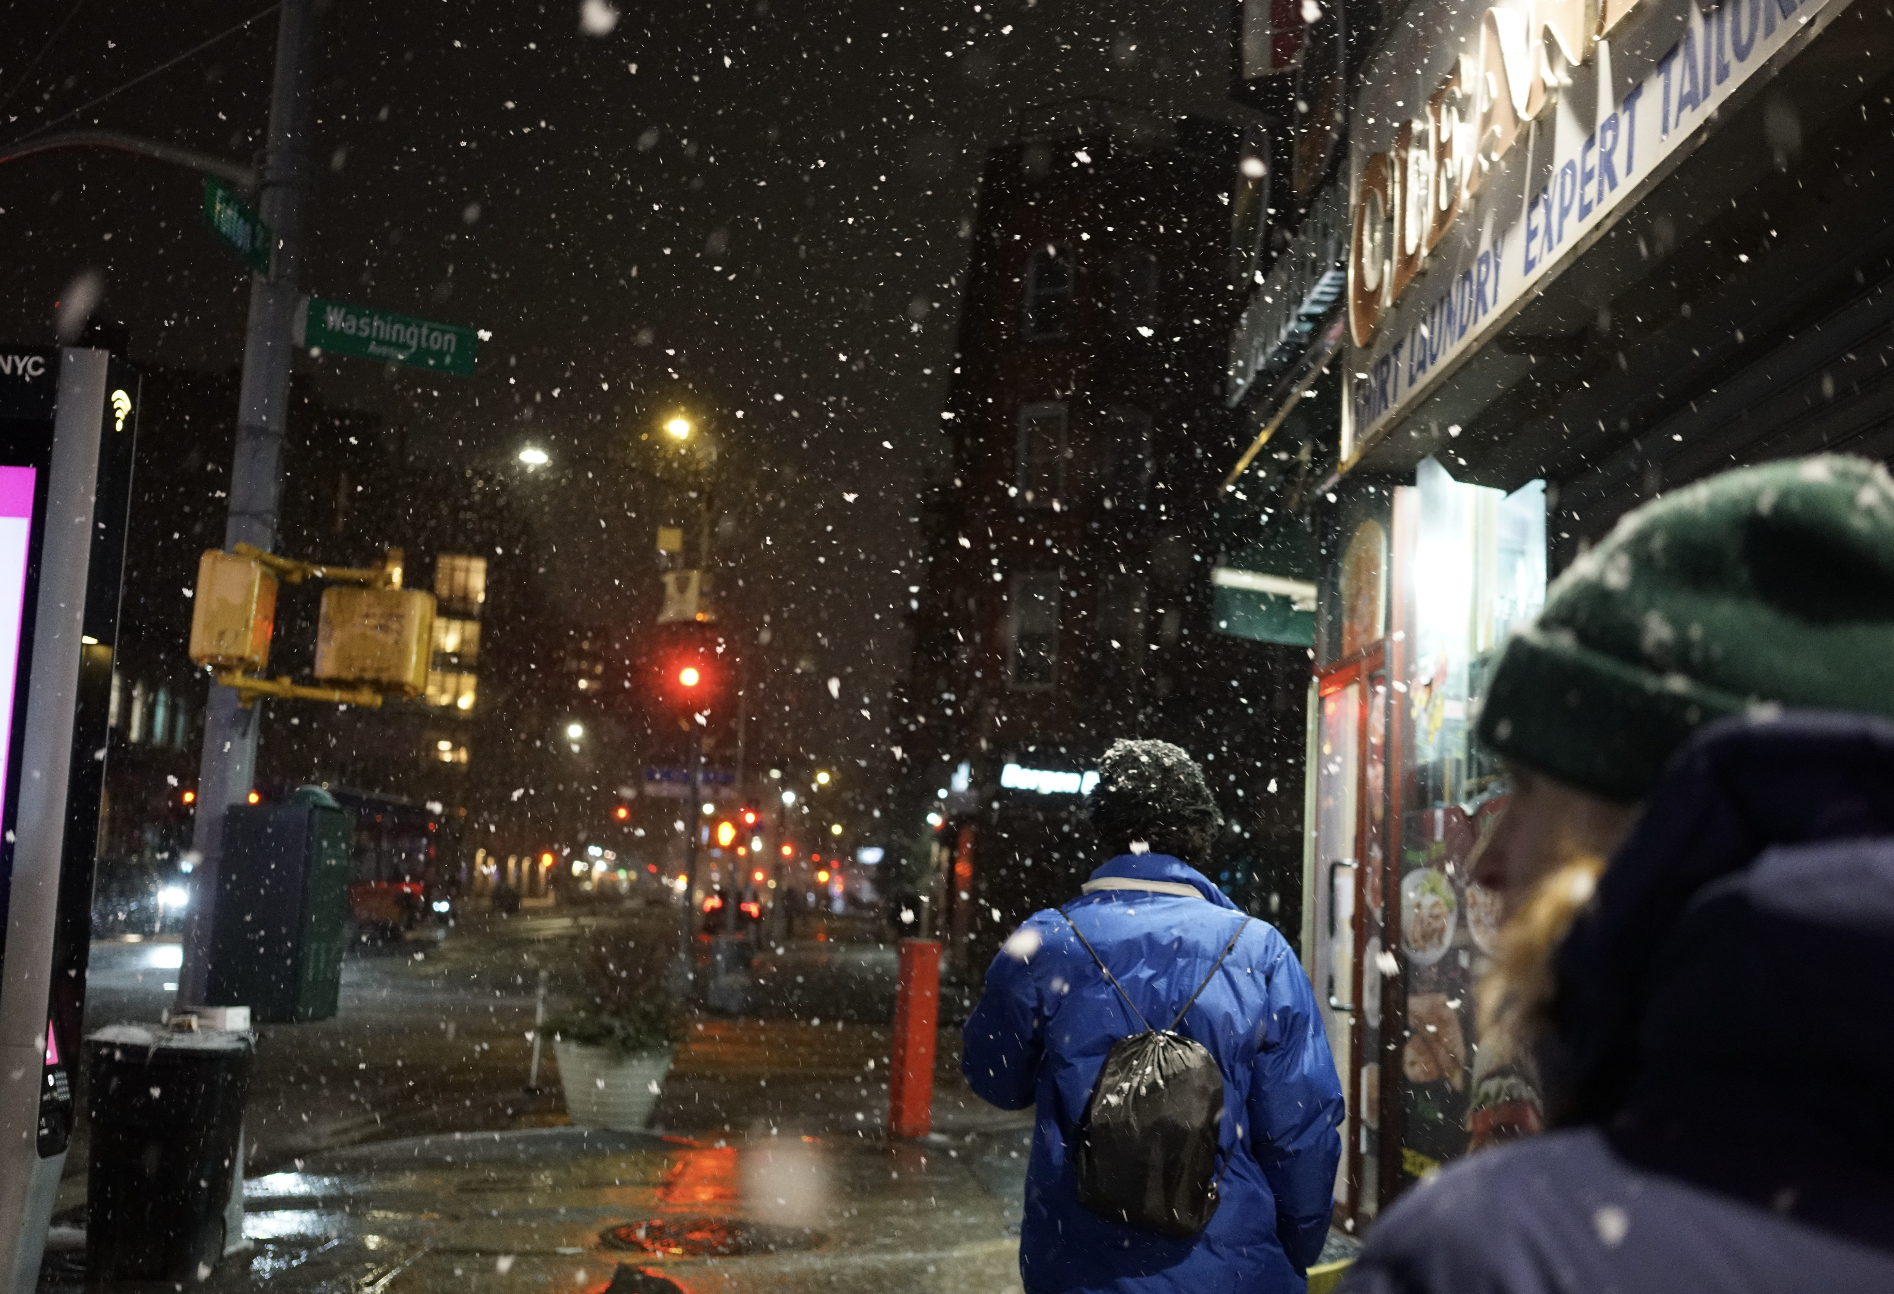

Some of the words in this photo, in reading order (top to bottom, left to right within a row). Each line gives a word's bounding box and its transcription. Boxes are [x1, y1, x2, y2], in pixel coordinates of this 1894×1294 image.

[1348, 0, 1638, 347] CLEAN
[1408, 230, 1506, 388] LAUNDRY
[1523, 80, 1644, 277] EXPERT
[1656, 0, 1806, 143] TAILO
[0, 354, 46, 377] NYC
[325, 304, 457, 353] Washington
